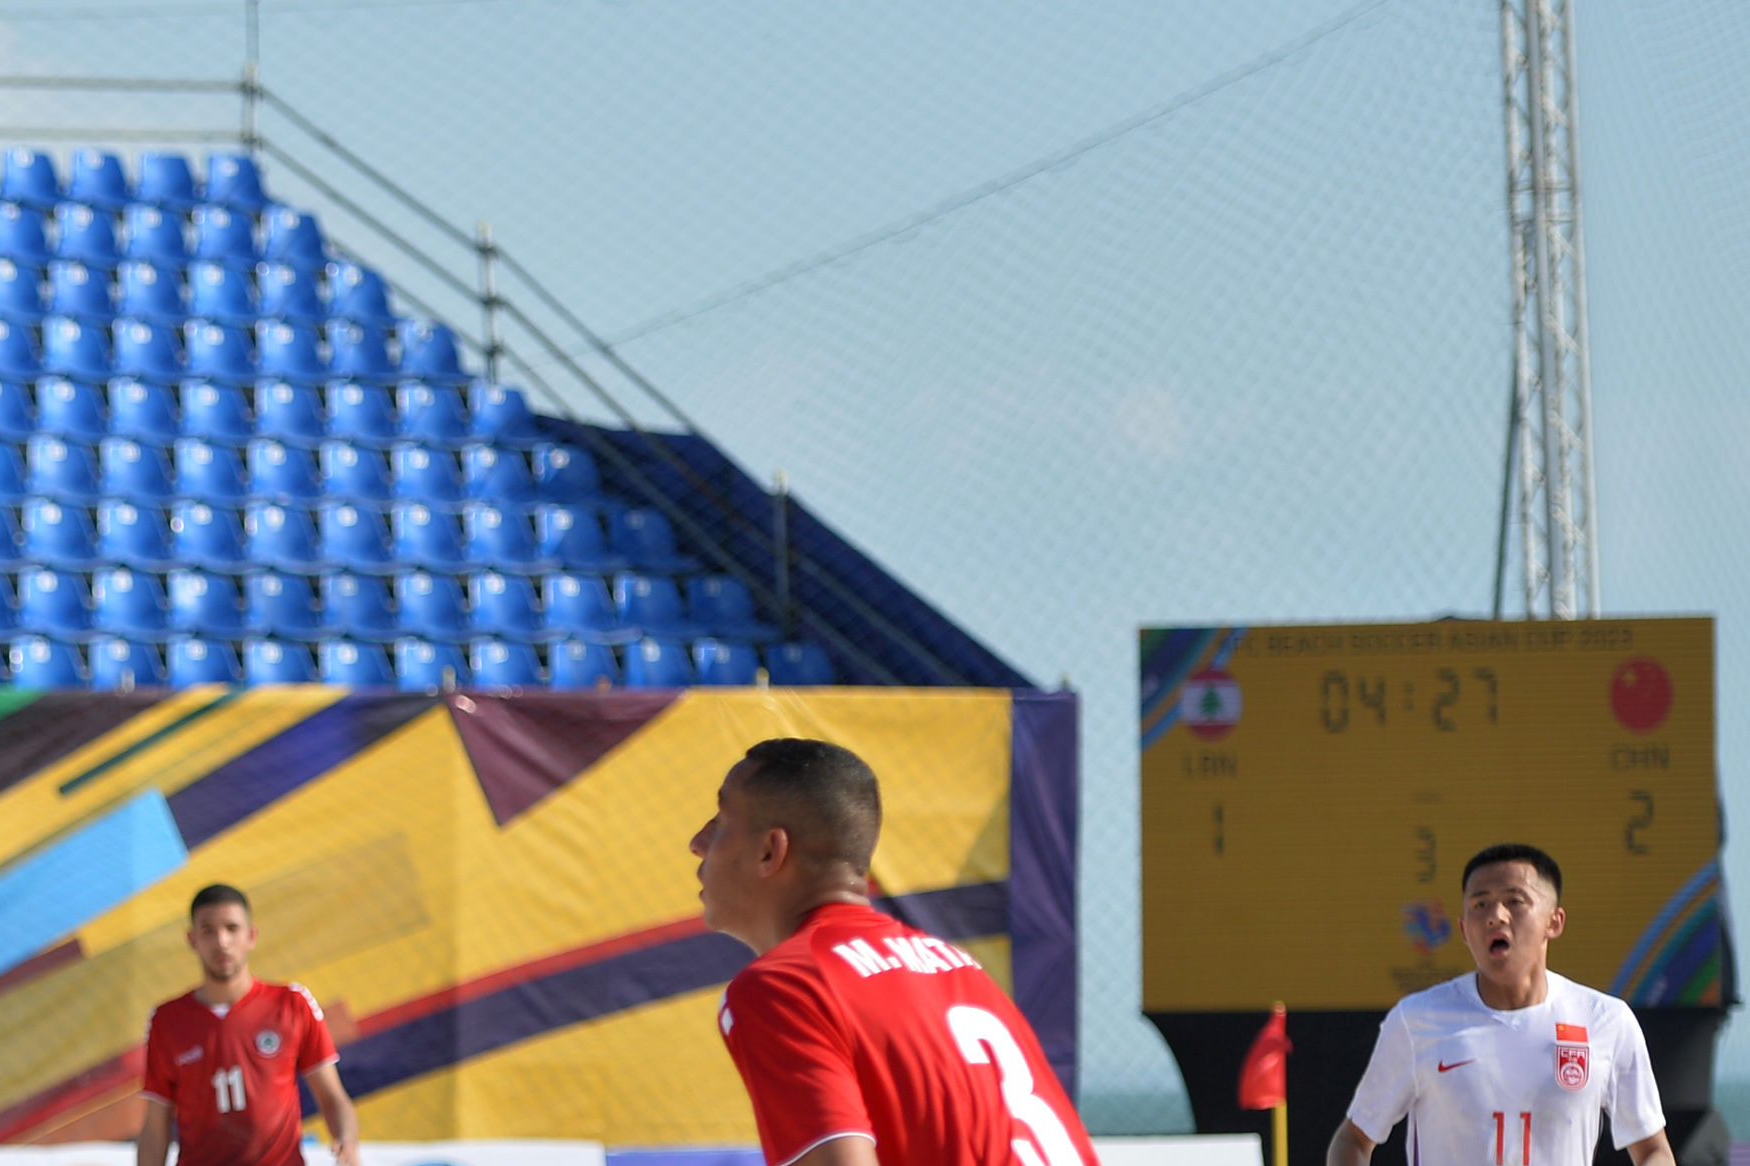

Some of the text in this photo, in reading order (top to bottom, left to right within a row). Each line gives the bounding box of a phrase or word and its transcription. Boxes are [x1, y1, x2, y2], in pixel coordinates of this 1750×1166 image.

[1322, 666, 1499, 733] 04:27
[1610, 745, 1670, 772] CHN
[1625, 789, 1655, 855] 2
[1415, 825, 1438, 883] 3
[211, 1064, 247, 1114] 11
